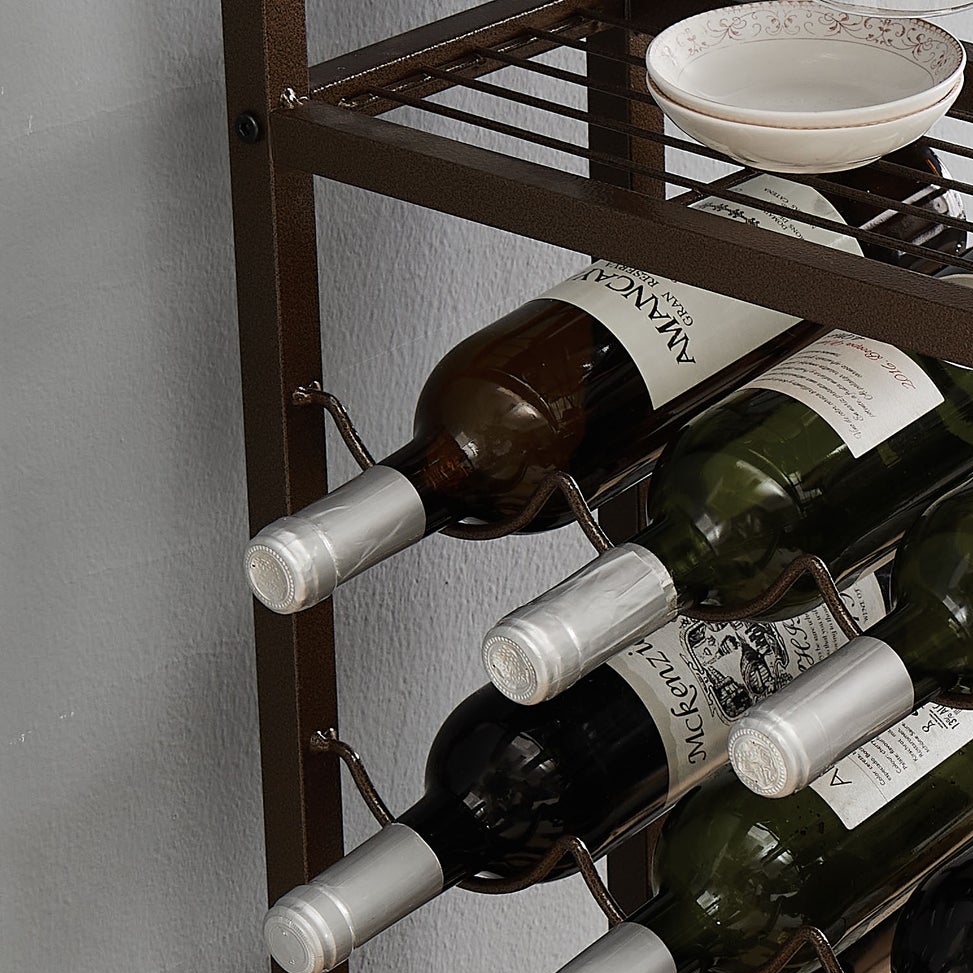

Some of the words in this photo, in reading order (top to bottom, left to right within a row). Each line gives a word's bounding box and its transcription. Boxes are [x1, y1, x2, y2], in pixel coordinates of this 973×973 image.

[661, 291, 692, 324] GRAN
[880, 360, 915, 388] 2016.
[943, 712, 959, 729] 13%
